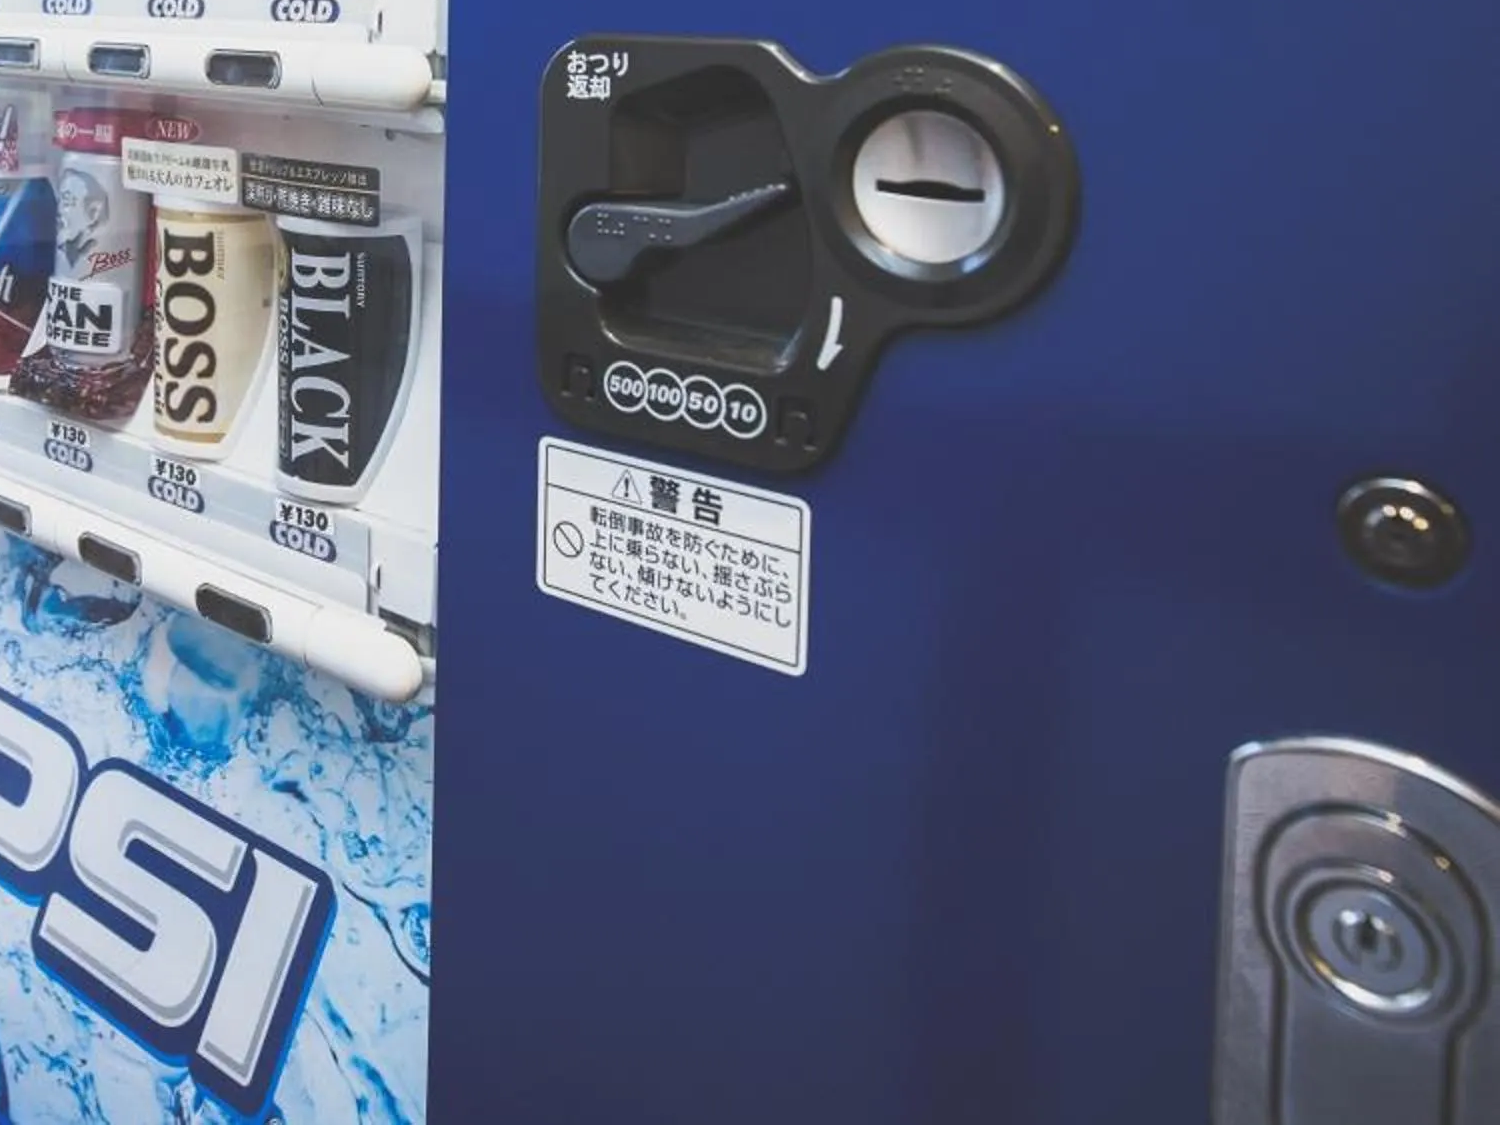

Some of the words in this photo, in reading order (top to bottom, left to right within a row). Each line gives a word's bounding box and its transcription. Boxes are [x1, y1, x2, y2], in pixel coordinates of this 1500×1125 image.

[566, 50, 630, 76] おつり
[566, 75, 612, 100] 返却
[156, 119, 193, 140] NEW
[51, 282, 83, 302] THE
[47, 299, 113, 332] AN
[163, 227, 218, 424] BOSS
[291, 247, 352, 469] BLACK
[608, 375, 644, 400] 500
[647, 383, 682, 407] 100
[687, 392, 720, 414] 50
[729, 401, 758, 424] 10
[51, 422, 88, 445] ¥130
[47, 440, 90, 470] COLD
[155, 458, 198, 486] ¥130
[152, 478, 199, 512] COLD
[649, 474, 724, 526] 警告
[280, 503, 329, 532] ¥130
[275, 522, 331, 558] COLD
[589, 505, 790, 579] 転倒事故を防ぐために、
[589, 529, 792, 604] 上に乗らない、揺さぶら
[589, 551, 792, 628] ない、傾けないようにし
[589, 573, 687, 620] てください。
